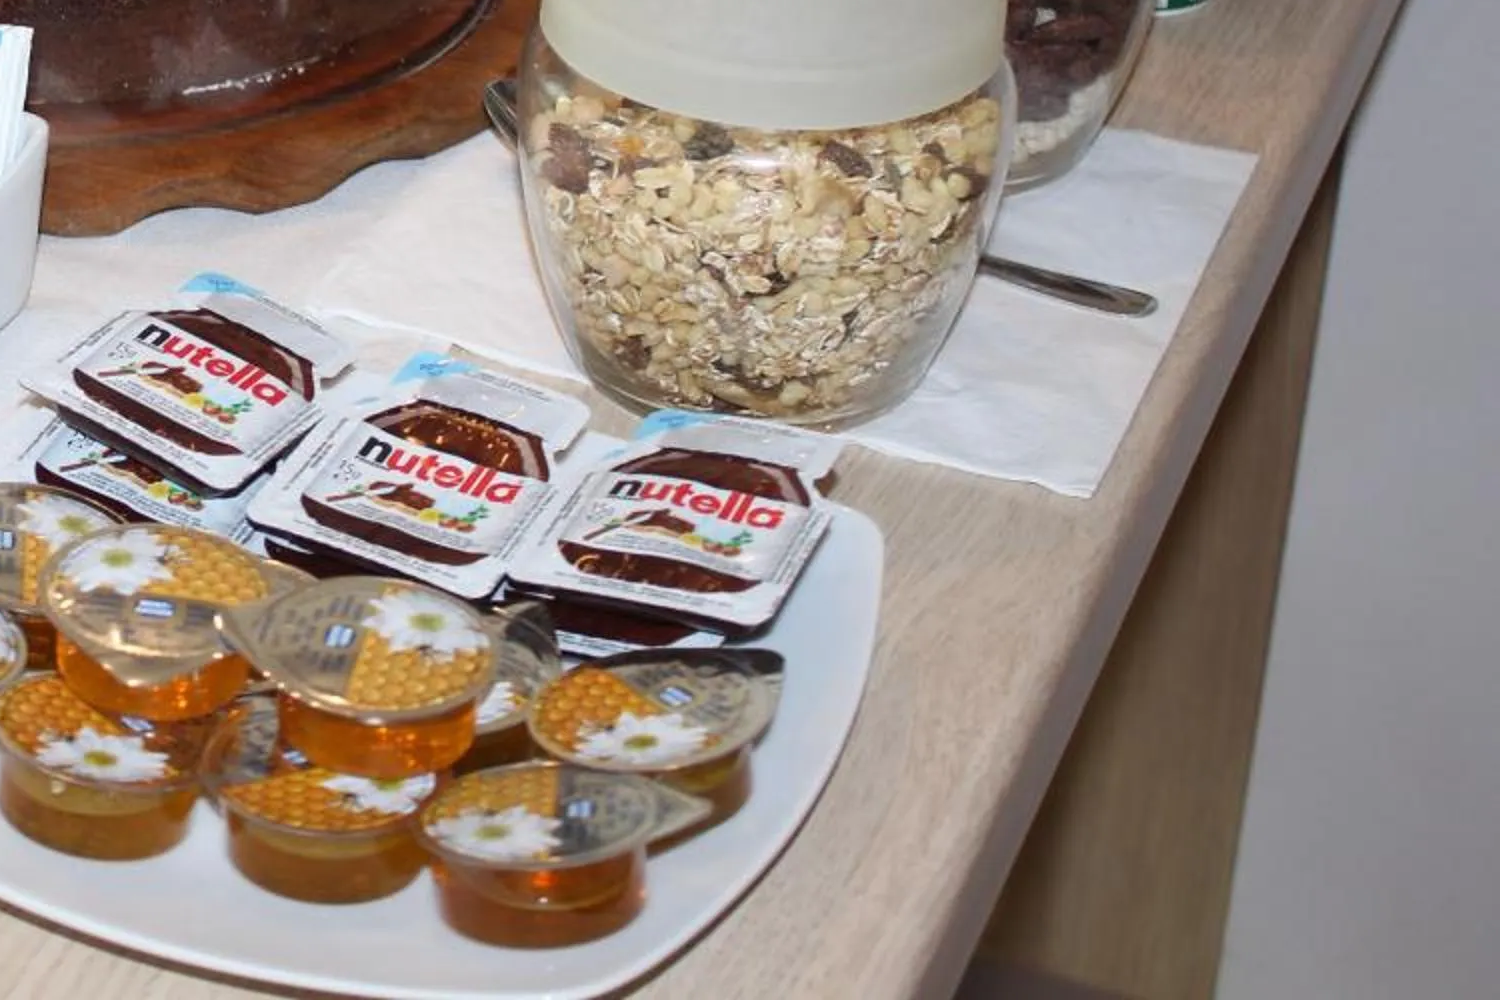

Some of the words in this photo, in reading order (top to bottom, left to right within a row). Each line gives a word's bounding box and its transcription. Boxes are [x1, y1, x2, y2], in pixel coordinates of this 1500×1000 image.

[134, 323, 290, 407] nutella
[358, 436, 524, 505] nutella
[608, 479, 786, 530] nutella
